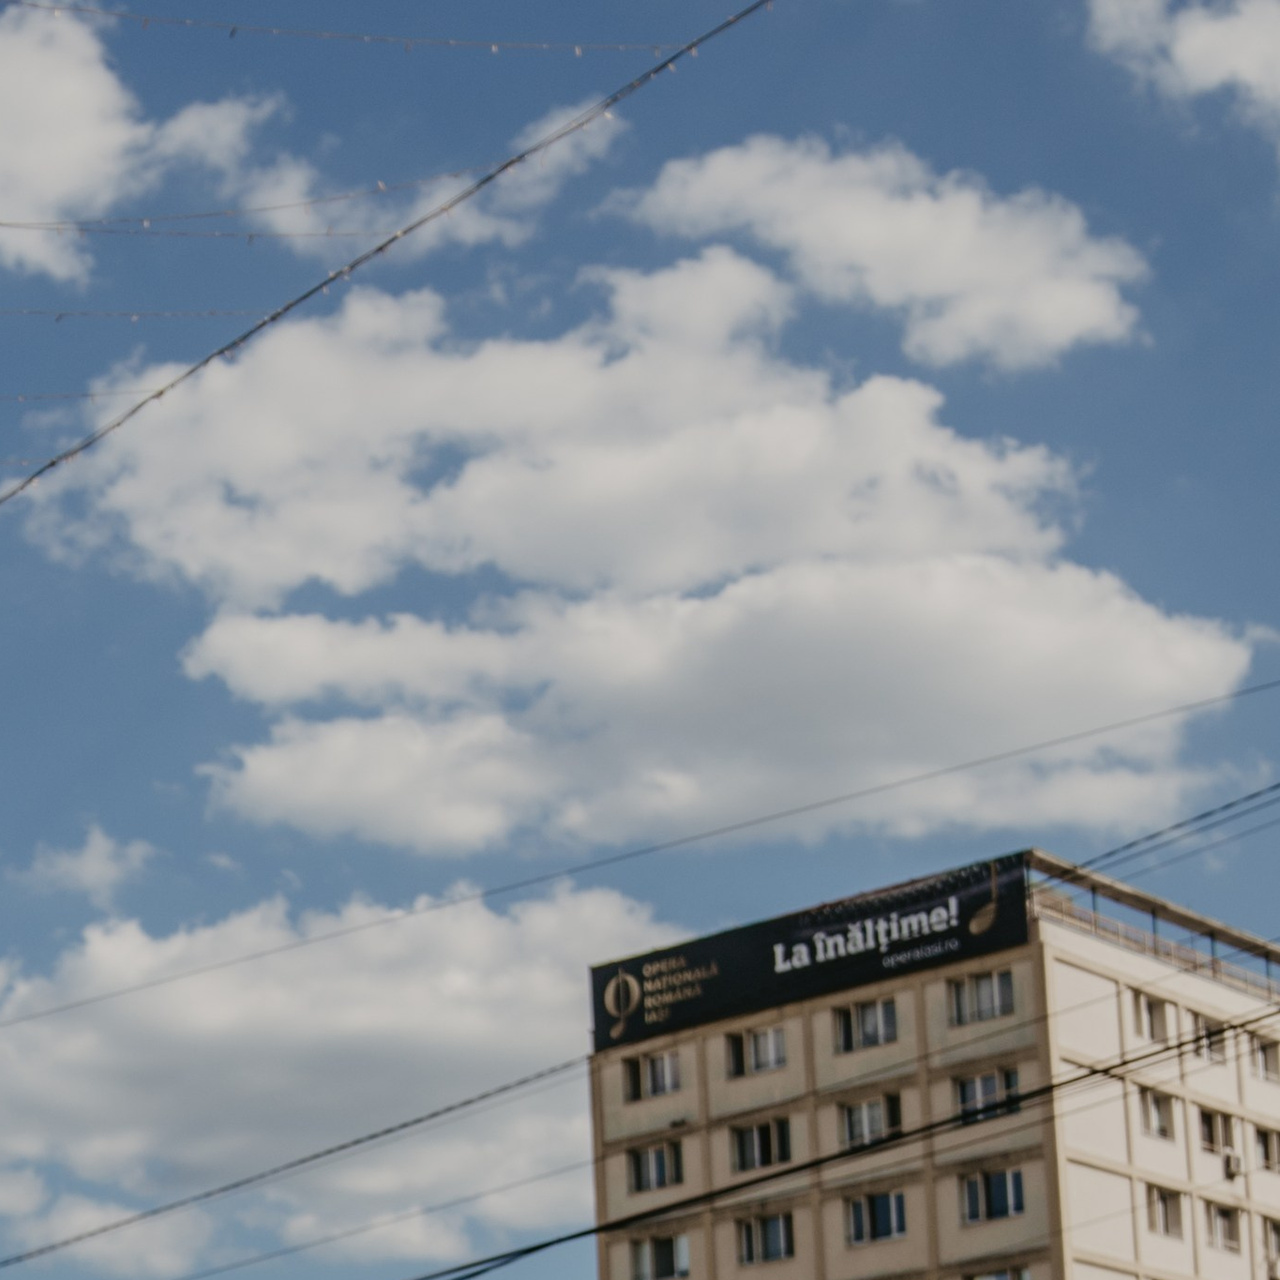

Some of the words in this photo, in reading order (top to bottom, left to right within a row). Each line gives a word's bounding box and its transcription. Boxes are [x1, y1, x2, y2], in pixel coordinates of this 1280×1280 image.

[643, 954, 687, 978] OPERA
[773, 942, 811, 974] La
[882, 938, 959, 968] operaiasi.ro
